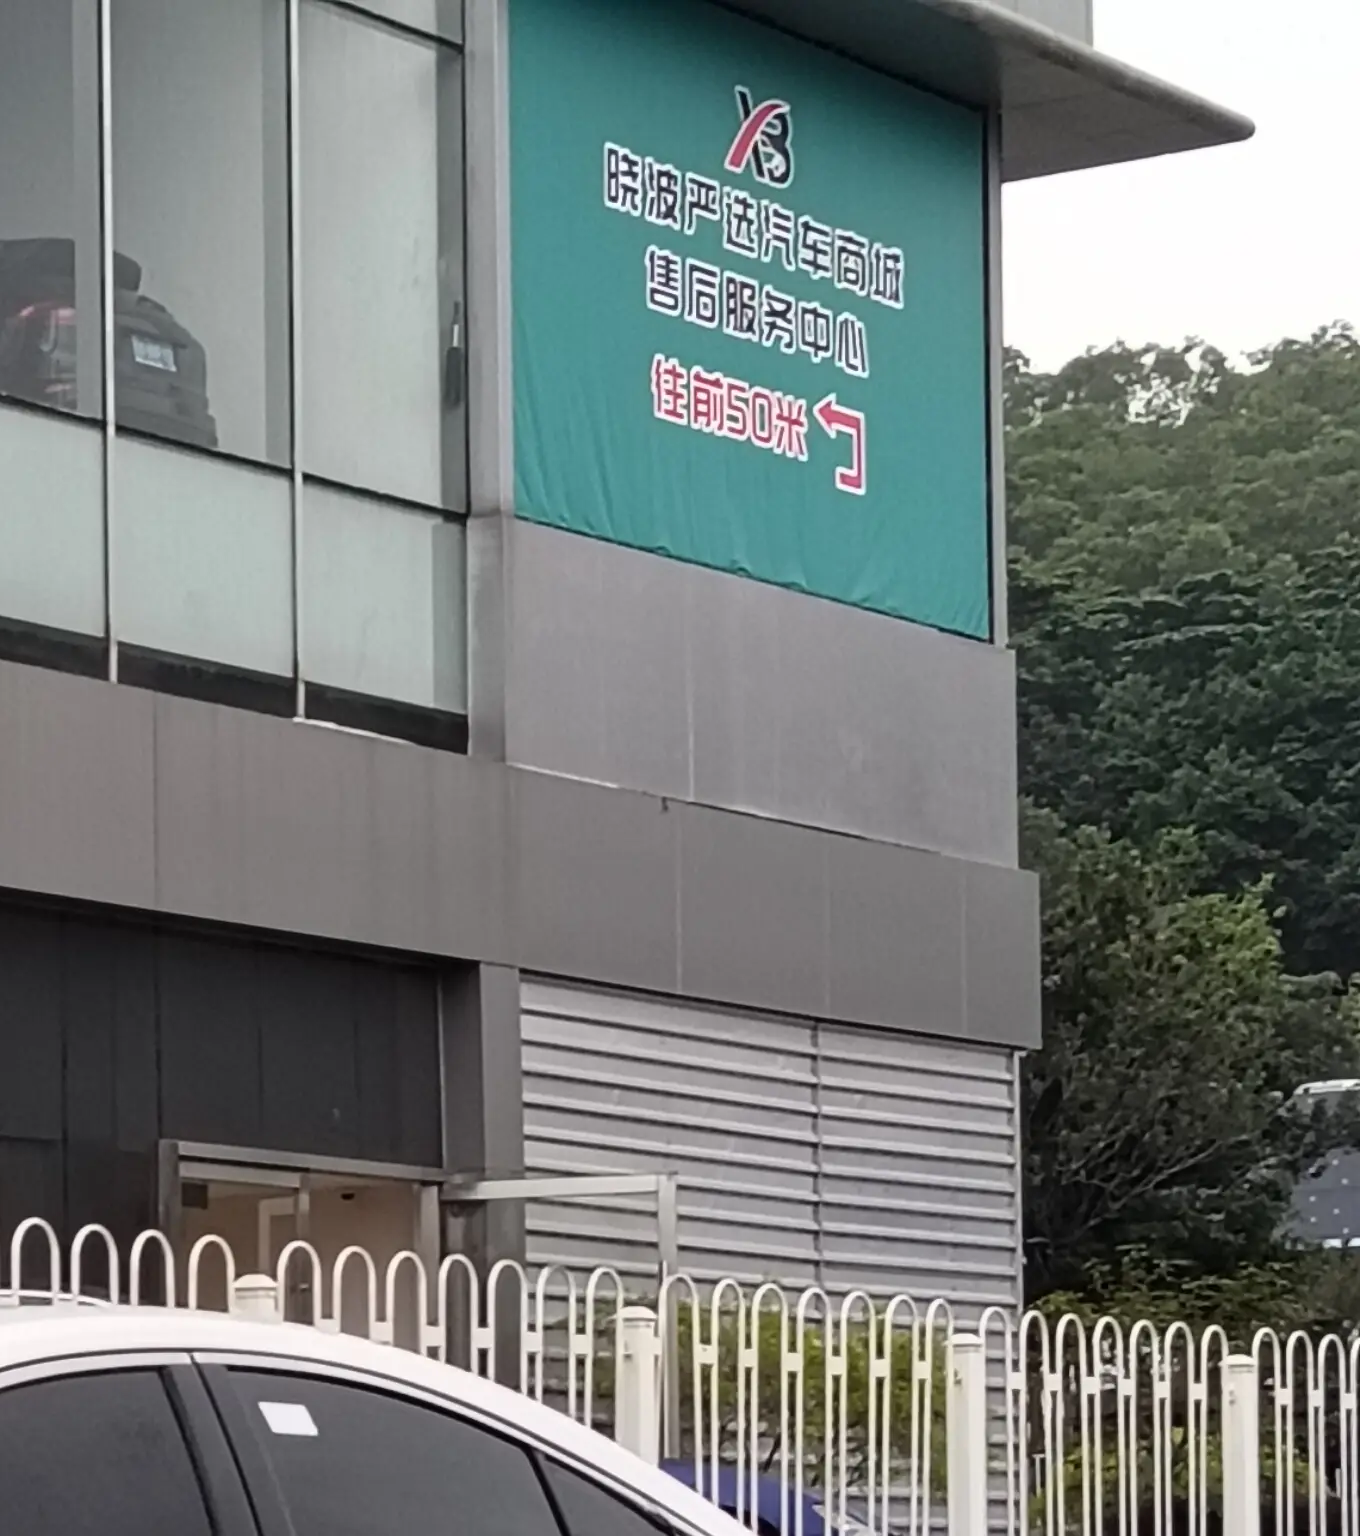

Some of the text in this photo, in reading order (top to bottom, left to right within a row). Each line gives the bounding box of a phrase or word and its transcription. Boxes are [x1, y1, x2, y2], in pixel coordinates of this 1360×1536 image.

[603, 141, 905, 309] 晓波严选汽车商城
[646, 245, 869, 378] 售后服务中心
